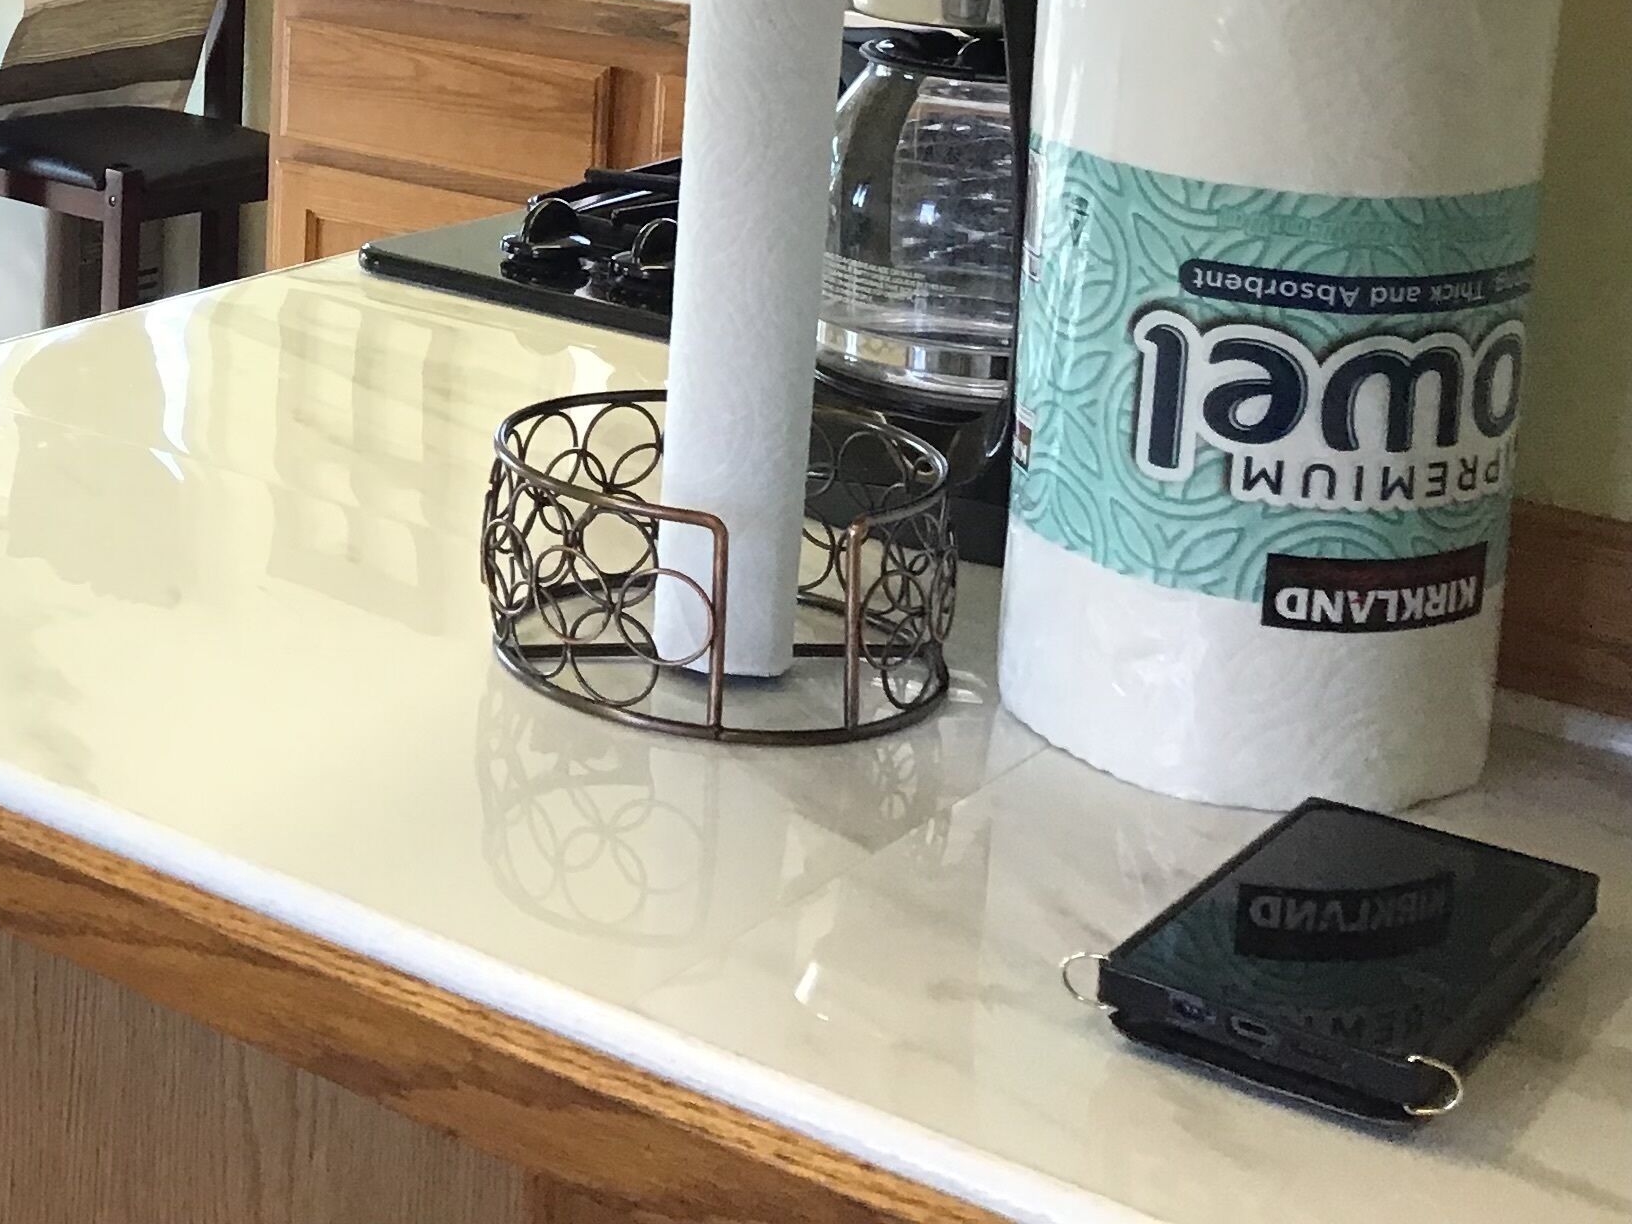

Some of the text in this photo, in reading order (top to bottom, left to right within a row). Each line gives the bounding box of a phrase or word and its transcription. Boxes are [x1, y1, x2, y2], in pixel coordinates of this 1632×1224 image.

[1193, 266, 1360, 308] Absorbent
[1371, 285, 1421, 306] and
[1430, 280, 1484, 305] Thick
[1140, 322, 1521, 469] owel
[1242, 455, 1502, 501] PREMIUM
[1273, 574, 1478, 625] KIRKLAND
